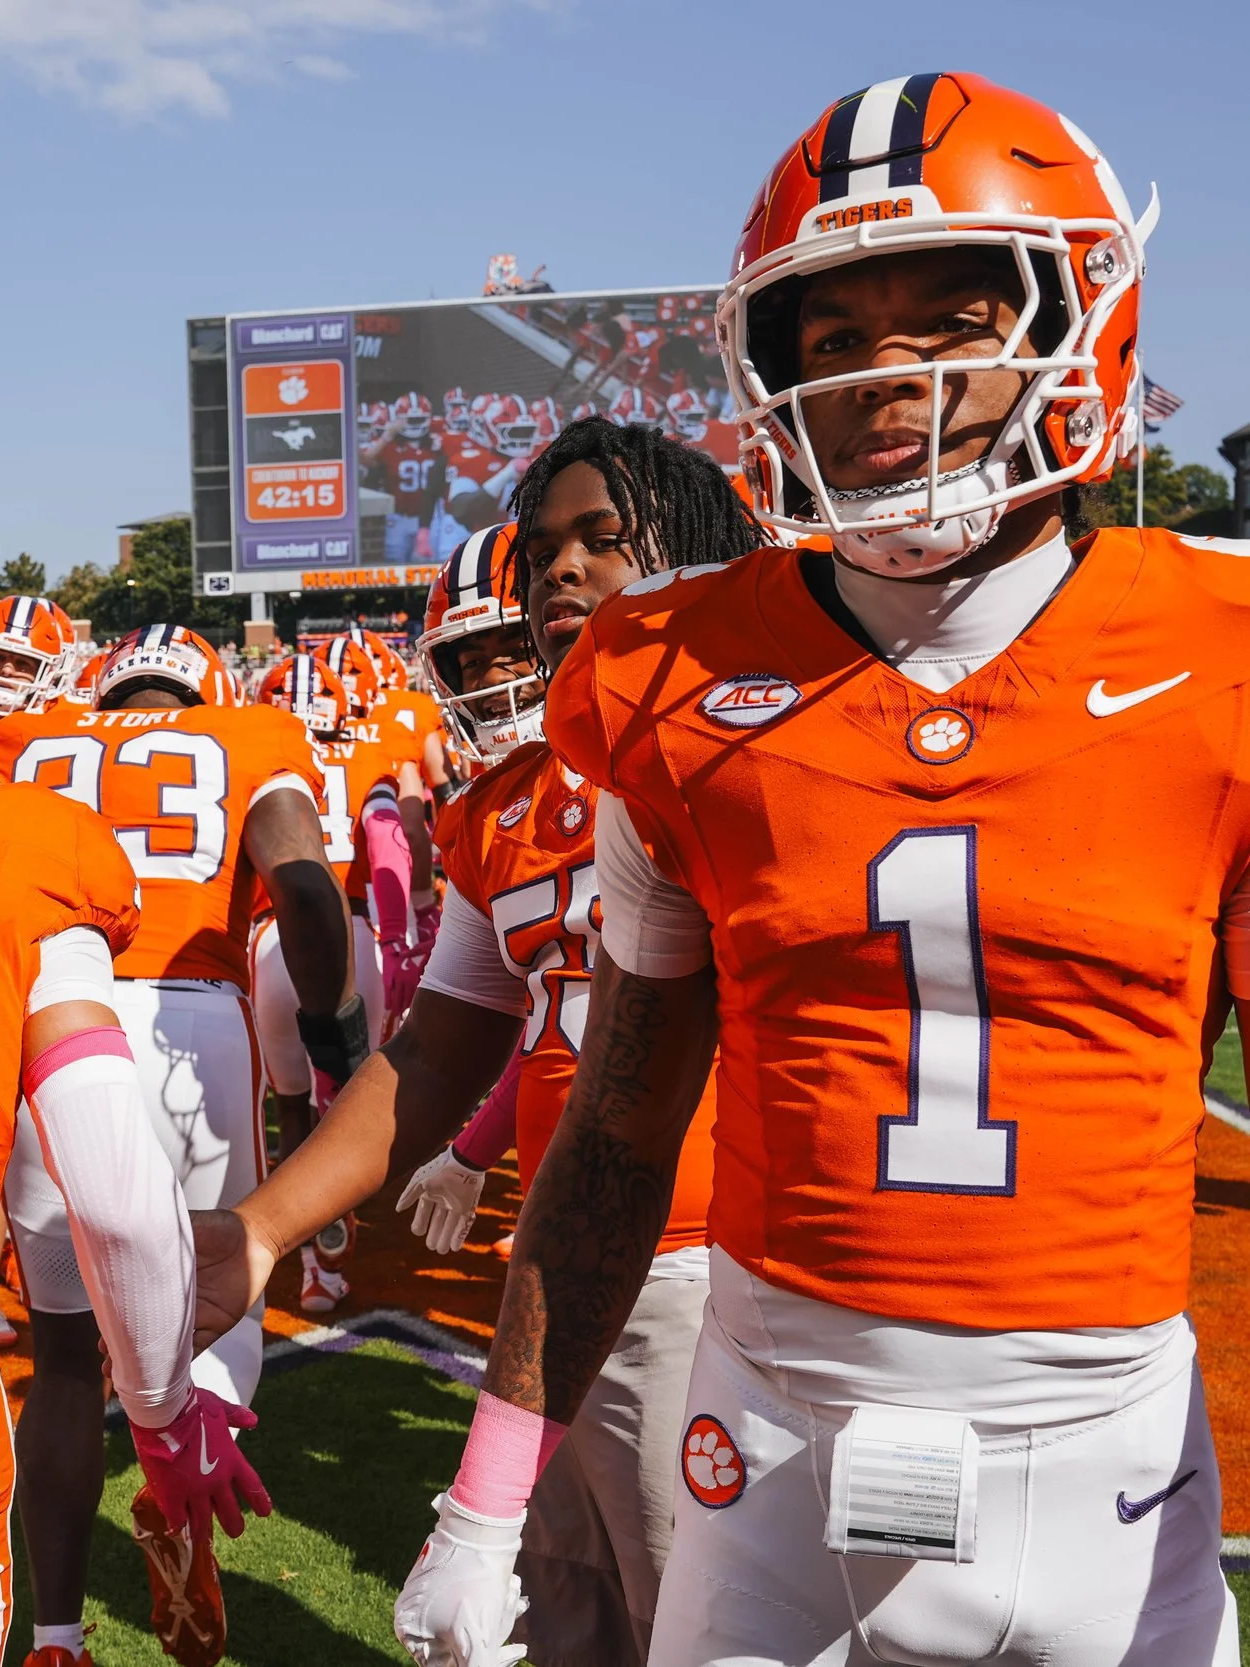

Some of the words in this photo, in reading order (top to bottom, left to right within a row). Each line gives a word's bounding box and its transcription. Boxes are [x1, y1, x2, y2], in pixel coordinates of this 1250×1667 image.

[816, 197, 913, 233] TIGERS
[319, 322, 344, 341] CAT
[766, 420, 798, 460] TIGERS
[257, 484, 336, 509] 42:15
[325, 539, 349, 558] CAT
[301, 567, 400, 592] MEMORIAL
[448, 604, 489, 623] TIGERS
[717, 684, 785, 708] ACC
[76, 708, 187, 728] STORY
[492, 734, 509, 746] ALL
[865, 823, 1019, 1197] 1
